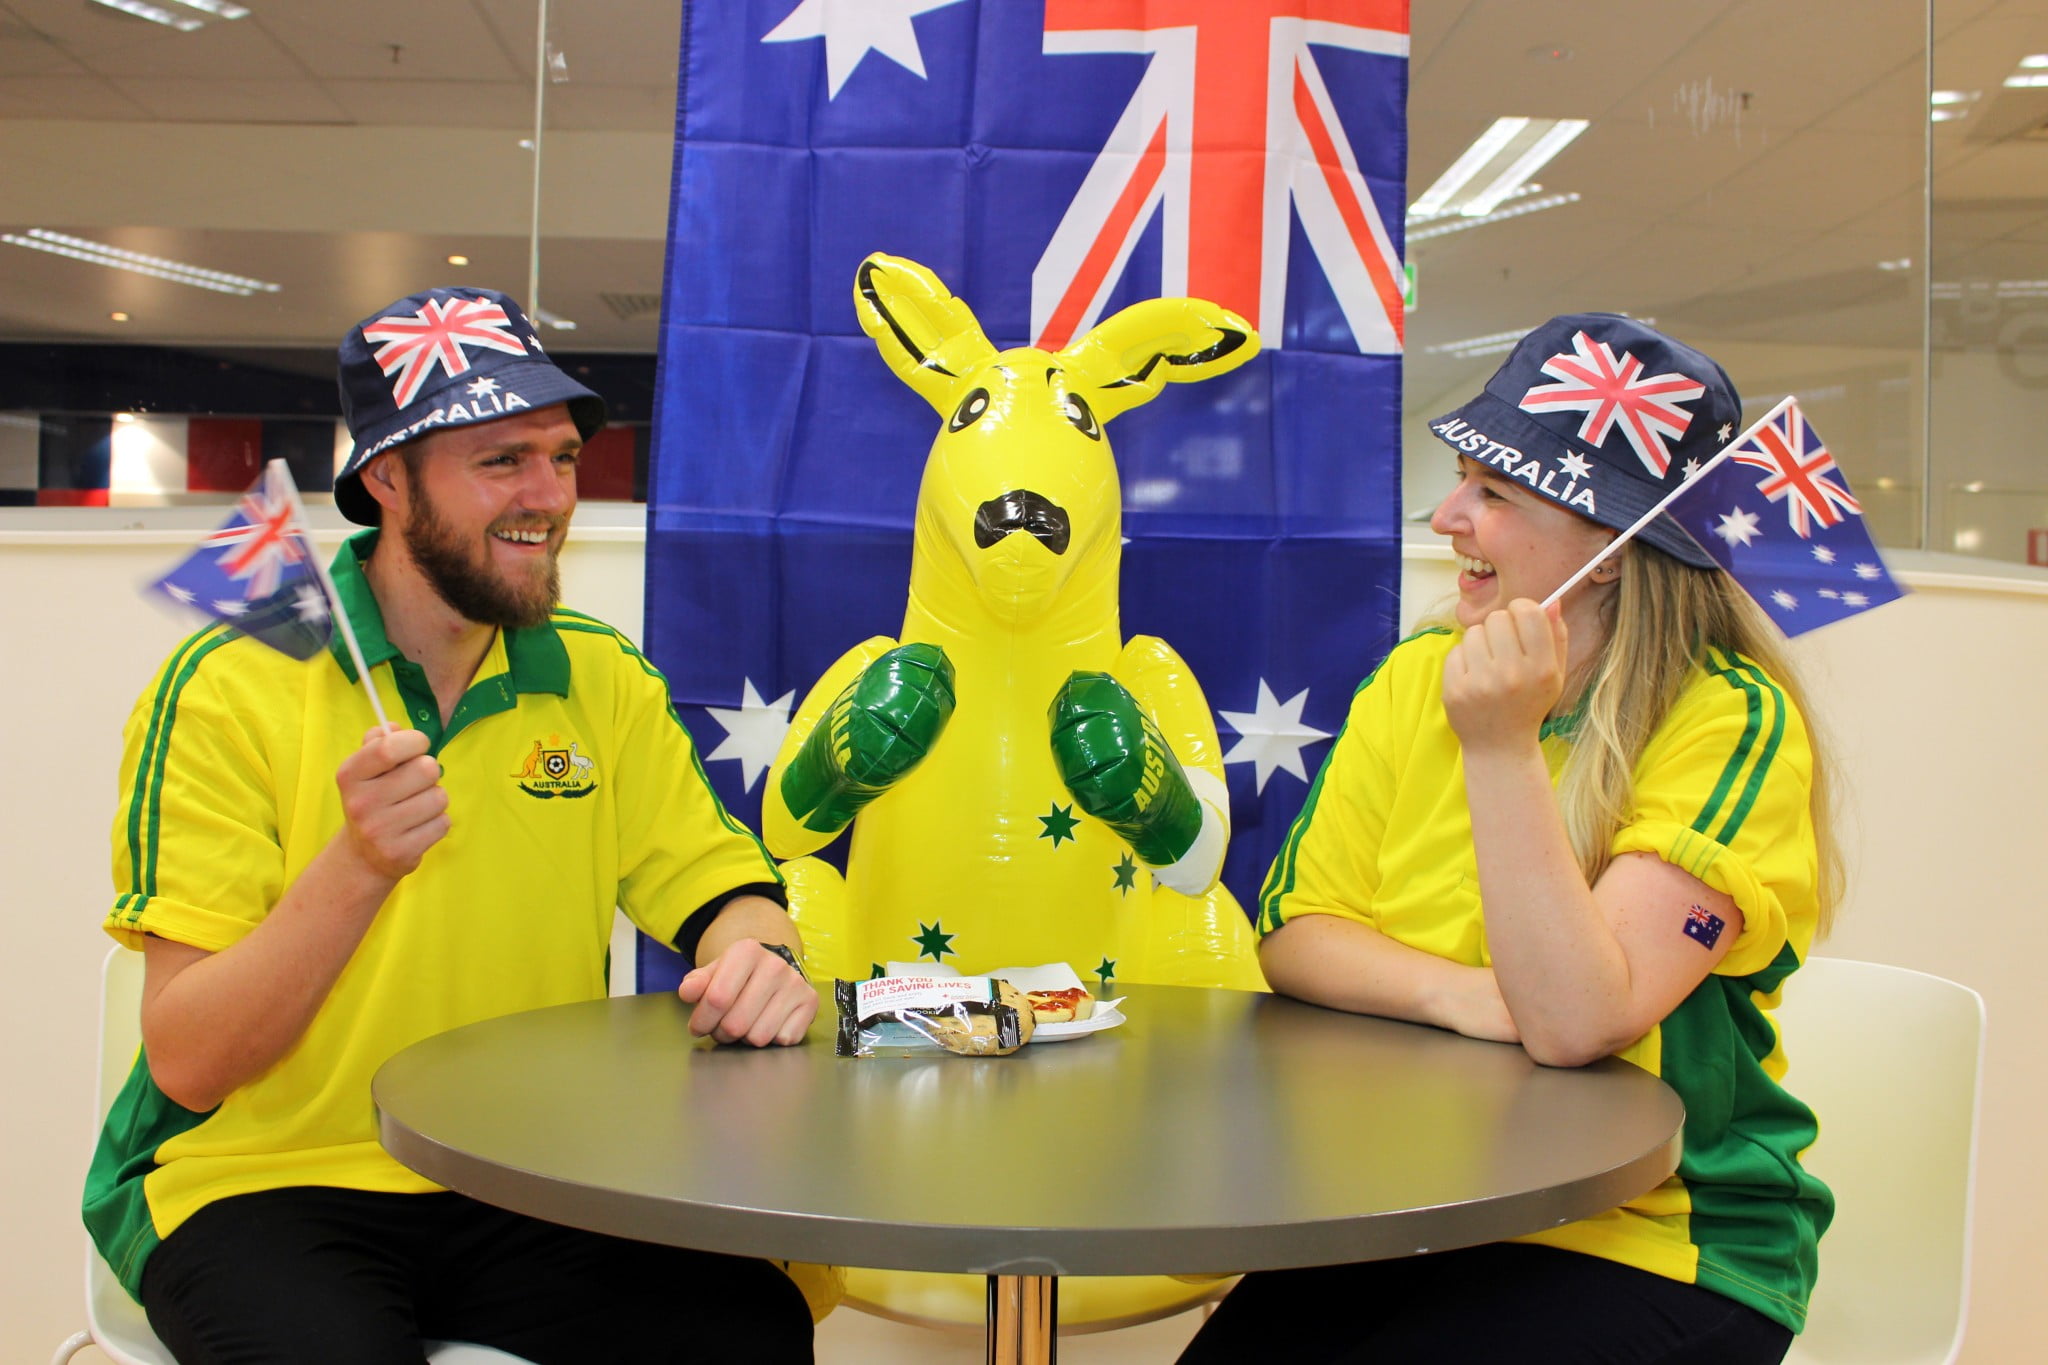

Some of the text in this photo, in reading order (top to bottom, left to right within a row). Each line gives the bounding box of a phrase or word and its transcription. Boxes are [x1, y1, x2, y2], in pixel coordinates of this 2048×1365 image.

[1432, 418, 1596, 515] AUSTRALIA
[863, 978, 904, 991] THANK
[863, 989, 885, 1000] FOR
[889, 982, 934, 994] SAVING
